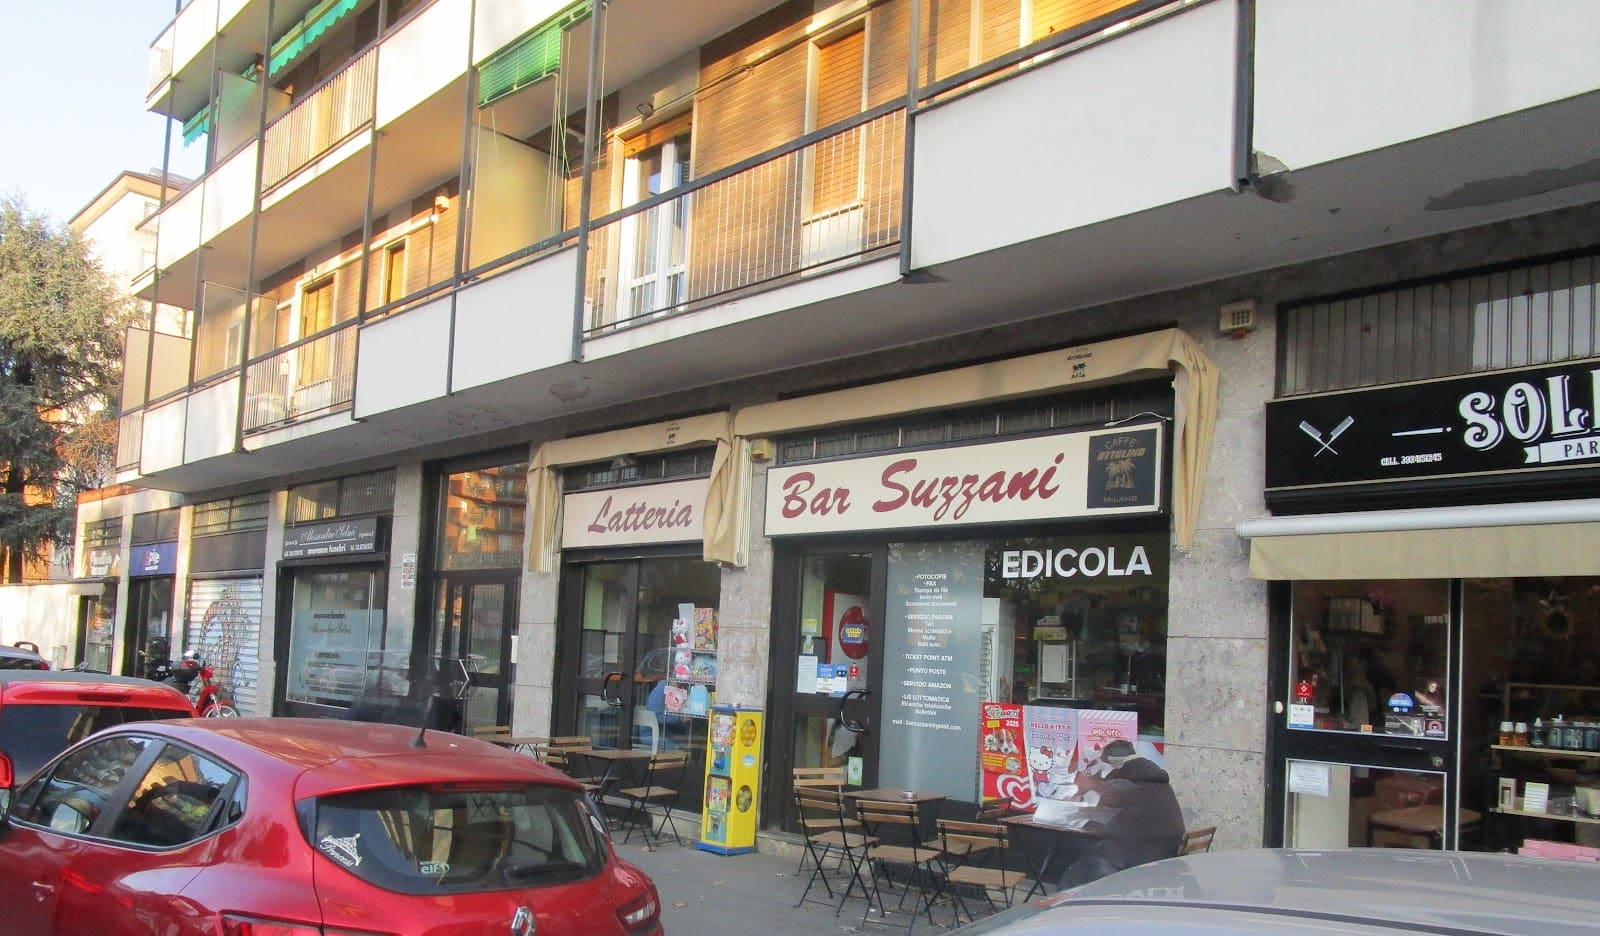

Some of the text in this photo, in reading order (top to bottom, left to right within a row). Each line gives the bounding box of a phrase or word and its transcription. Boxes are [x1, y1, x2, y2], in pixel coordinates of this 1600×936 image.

[1564, 440, 1598, 457] PAR
[782, 452, 1065, 521] Bar Suzzani
[1103, 495, 1138, 503] MILANO
[587, 495, 693, 533] Latteria
[1002, 545, 1153, 578] EDICOLA
[927, 681, 952, 689] AMAZON
[912, 694, 950, 703] LOTTOMATICA
[1030, 721, 1049, 729] HELLO
[319, 840, 356, 867] Princess
[420, 862, 441, 874] elf
